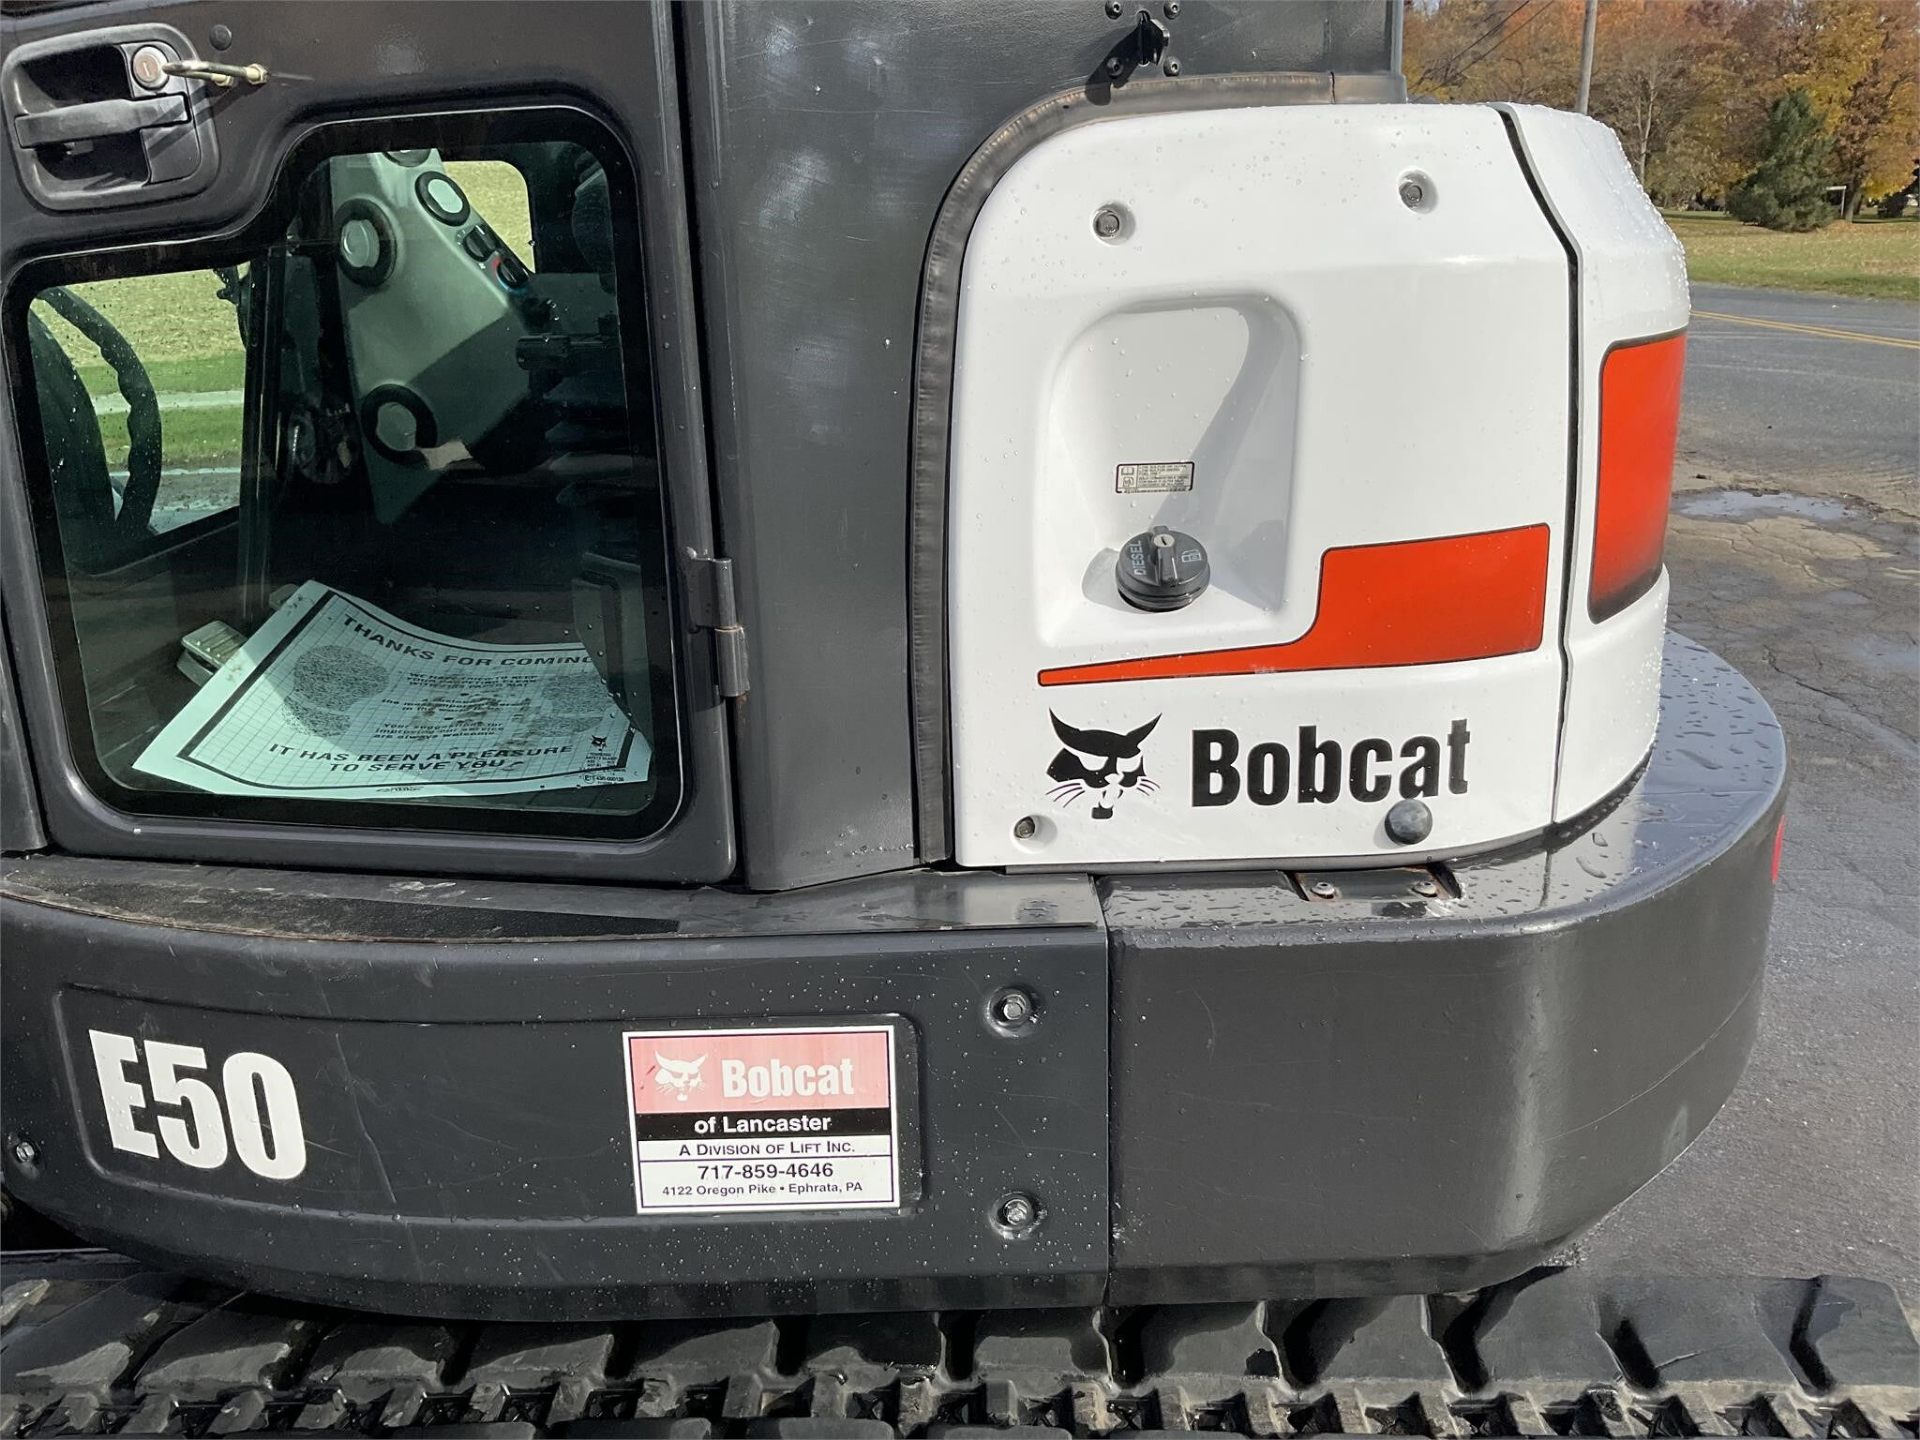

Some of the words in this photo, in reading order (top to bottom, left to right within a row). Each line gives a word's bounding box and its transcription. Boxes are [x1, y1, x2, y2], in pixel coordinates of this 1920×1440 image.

[1129, 540, 1147, 576] DIESEL
[342, 614, 435, 660] THANKS
[442, 655, 492, 666] FOR
[269, 743, 295, 755] IT
[300, 750, 349, 761] HAS
[357, 753, 420, 762] BEEN
[426, 753, 441, 761] A
[450, 744, 574, 760] PLEASURE
[1191, 718, 1471, 807] Bobcat
[329, 763, 359, 772] TO
[367, 761, 451, 772] SERVE
[721, 1057, 855, 1098] Bobcat
[88, 1029, 307, 1180] E50
[694, 1116, 718, 1134] of
[723, 1114, 832, 1133] Lancaster
[679, 1144, 690, 1156] A
[697, 1142, 760, 1156] DIVISION
[766, 1143, 785, 1154] OF
[790, 1141, 821, 1154] LIFT
[826, 1140, 855, 1153] INC.
[698, 1162, 834, 1180] 717-859-4646
[662, 1185, 693, 1196] 4122
[696, 1184, 745, 1198] Oregon
[749, 1183, 777, 1194] Pike
[788, 1182, 843, 1195] Ephrata,
[846, 1181, 863, 1193] PA
